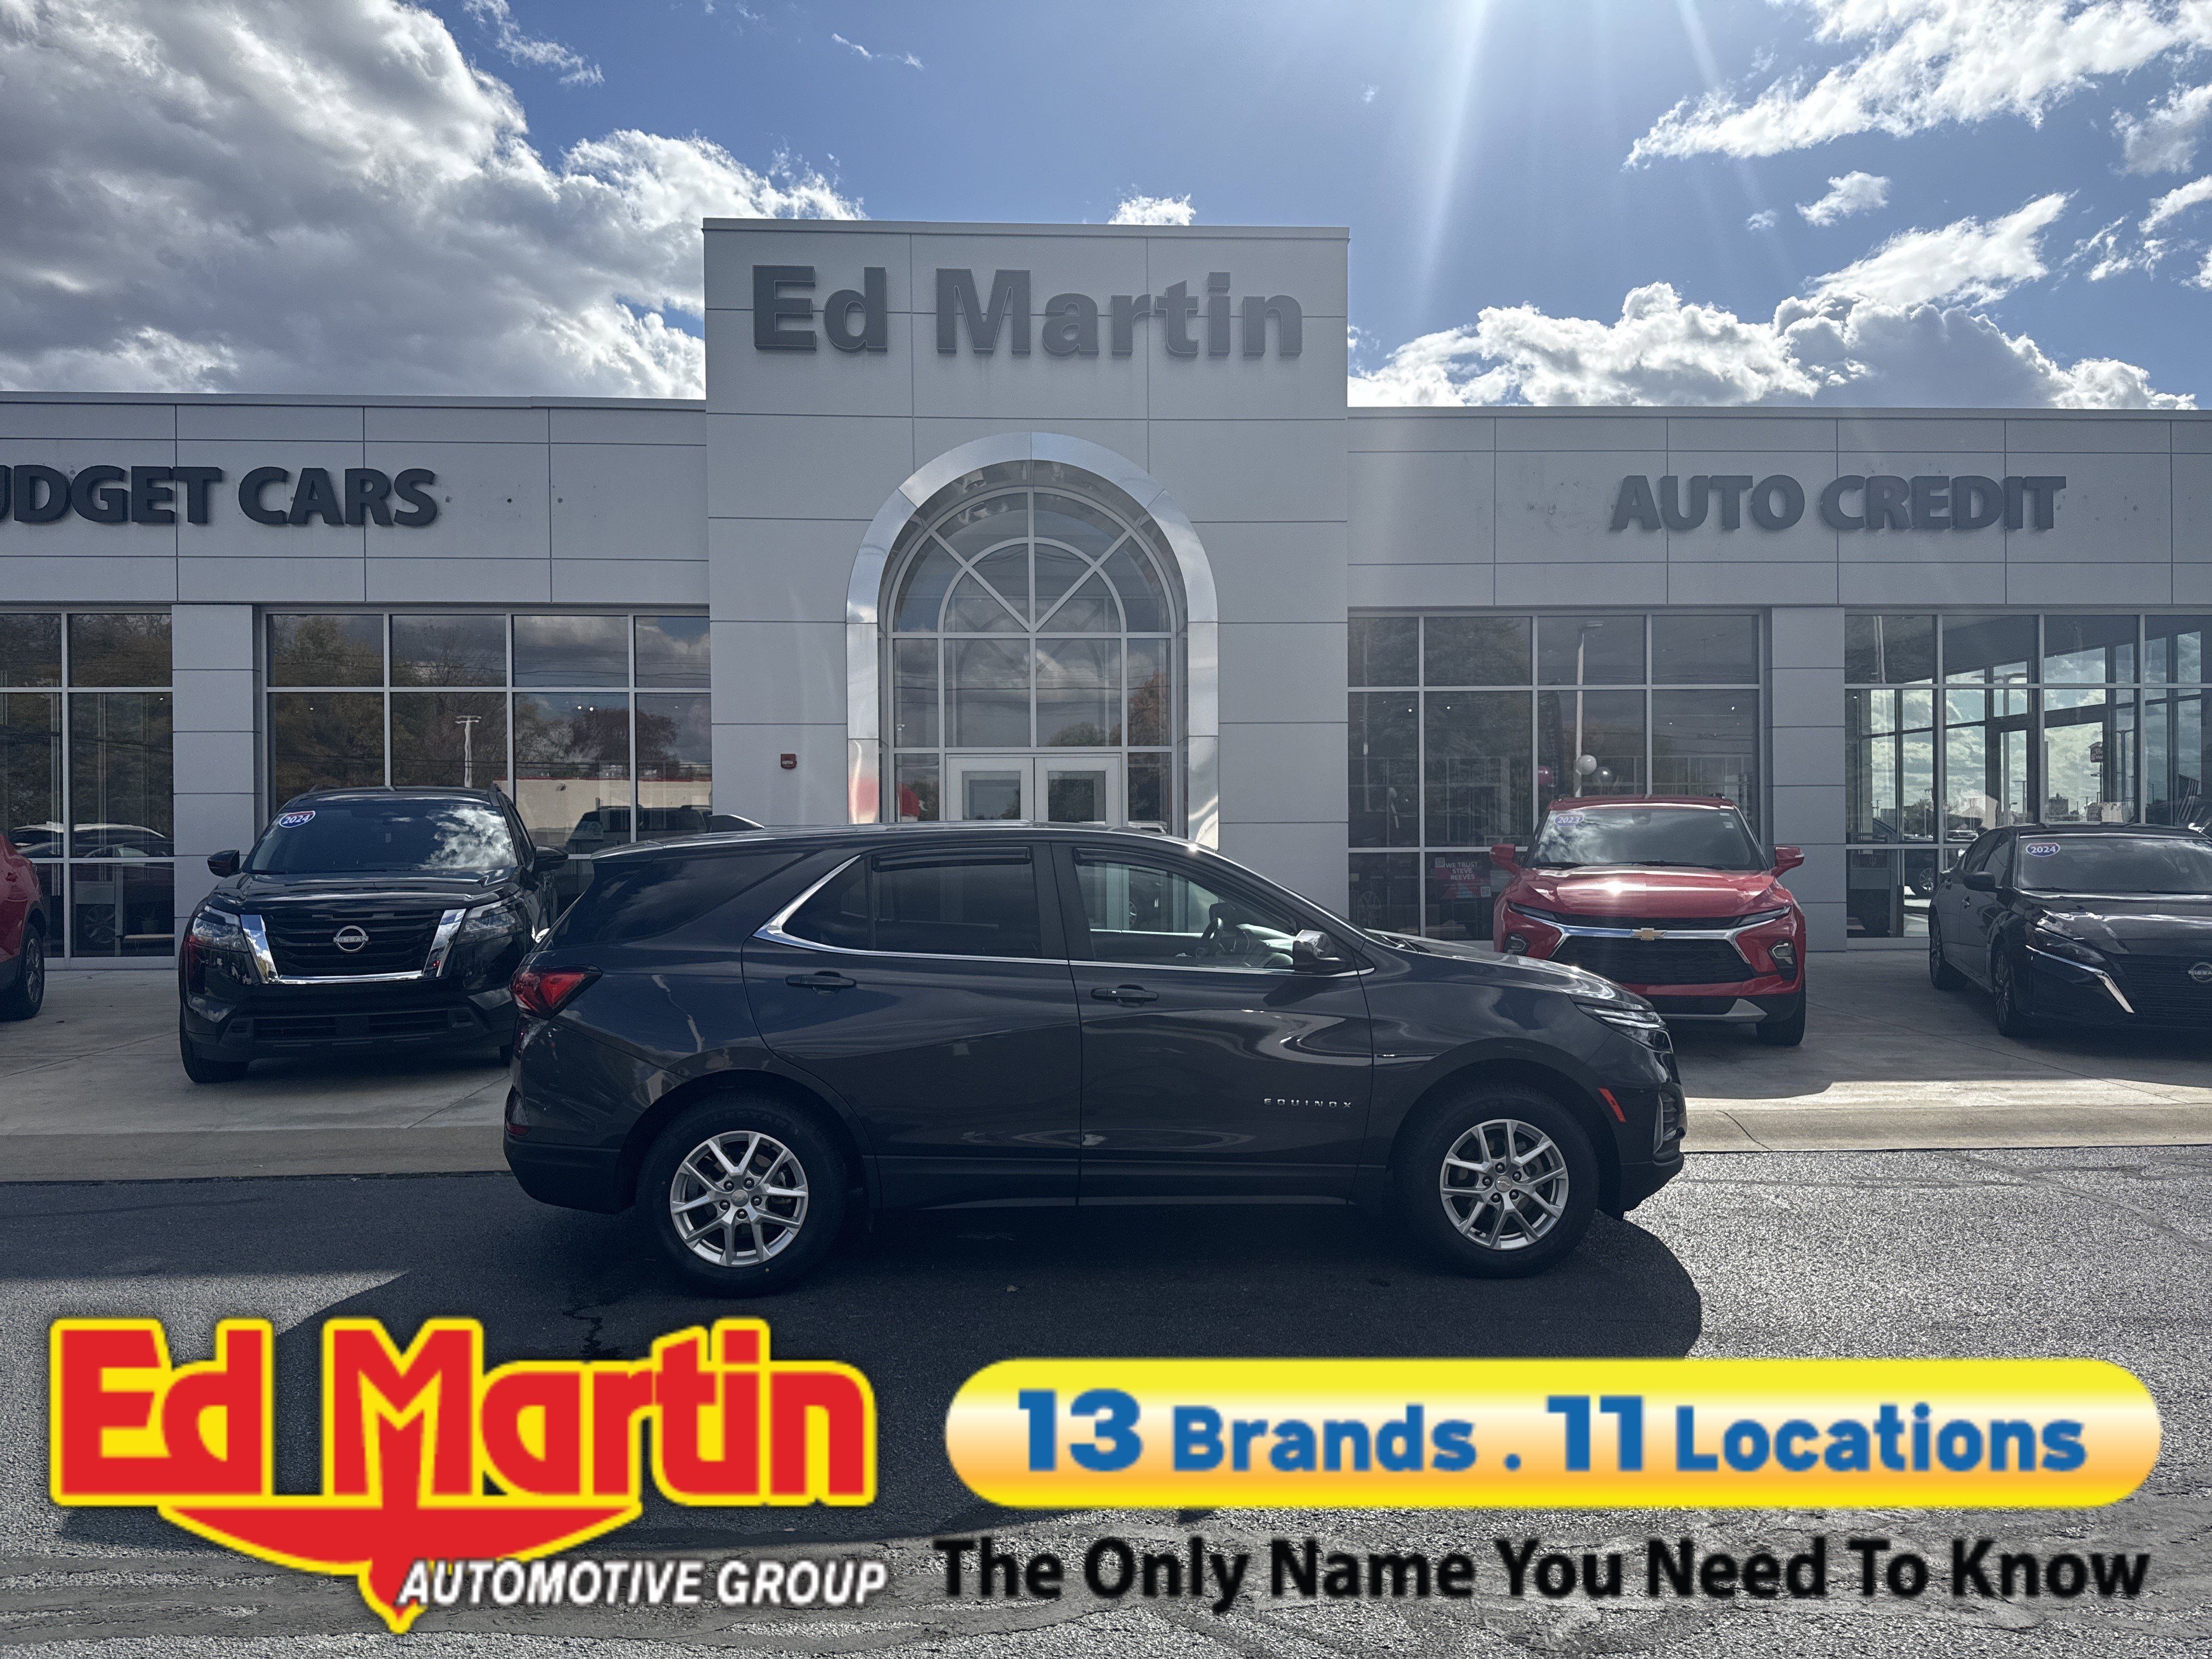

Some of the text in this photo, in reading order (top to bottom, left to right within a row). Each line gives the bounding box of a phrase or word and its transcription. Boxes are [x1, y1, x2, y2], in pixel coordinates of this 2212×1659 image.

[753, 265, 1304, 357] Ed Martin
[0, 465, 437, 527] DGET CARS
[1610, 475, 2067, 531] AUTO CREDIT
[282, 814, 311, 825] 2024
[1263, 1097, 1352, 1109] EQUINOX
